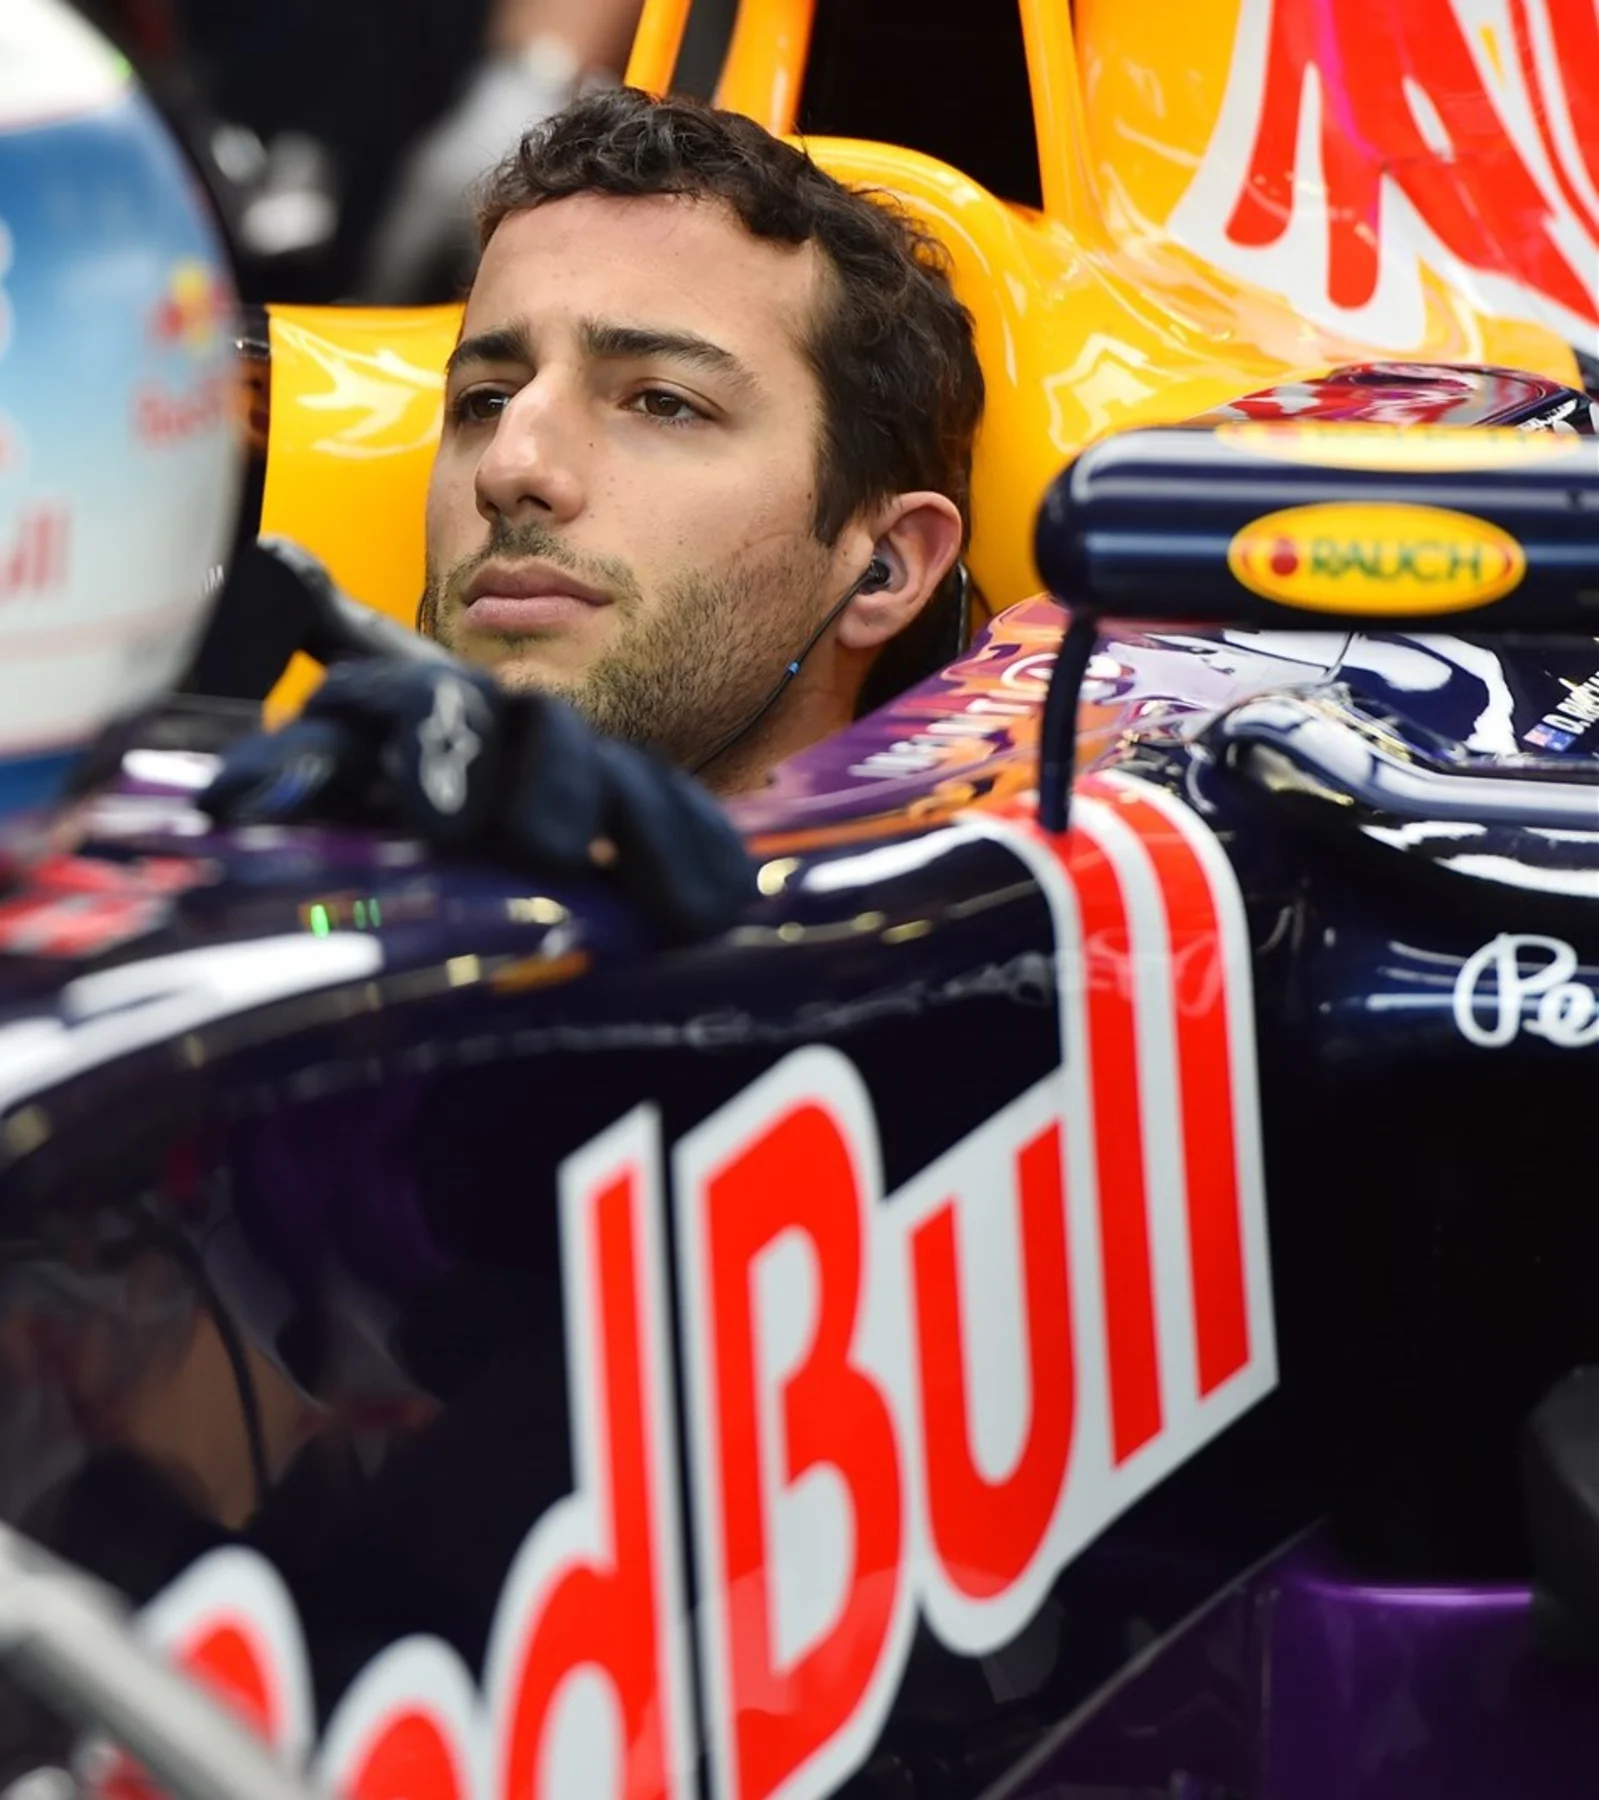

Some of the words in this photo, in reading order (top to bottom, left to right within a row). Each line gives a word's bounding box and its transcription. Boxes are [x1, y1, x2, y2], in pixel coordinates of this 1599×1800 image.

[1310, 540, 1484, 583] RAUCH
[1453, 932, 1599, 1048] Pe
[685, 775, 1270, 1800] Bull
